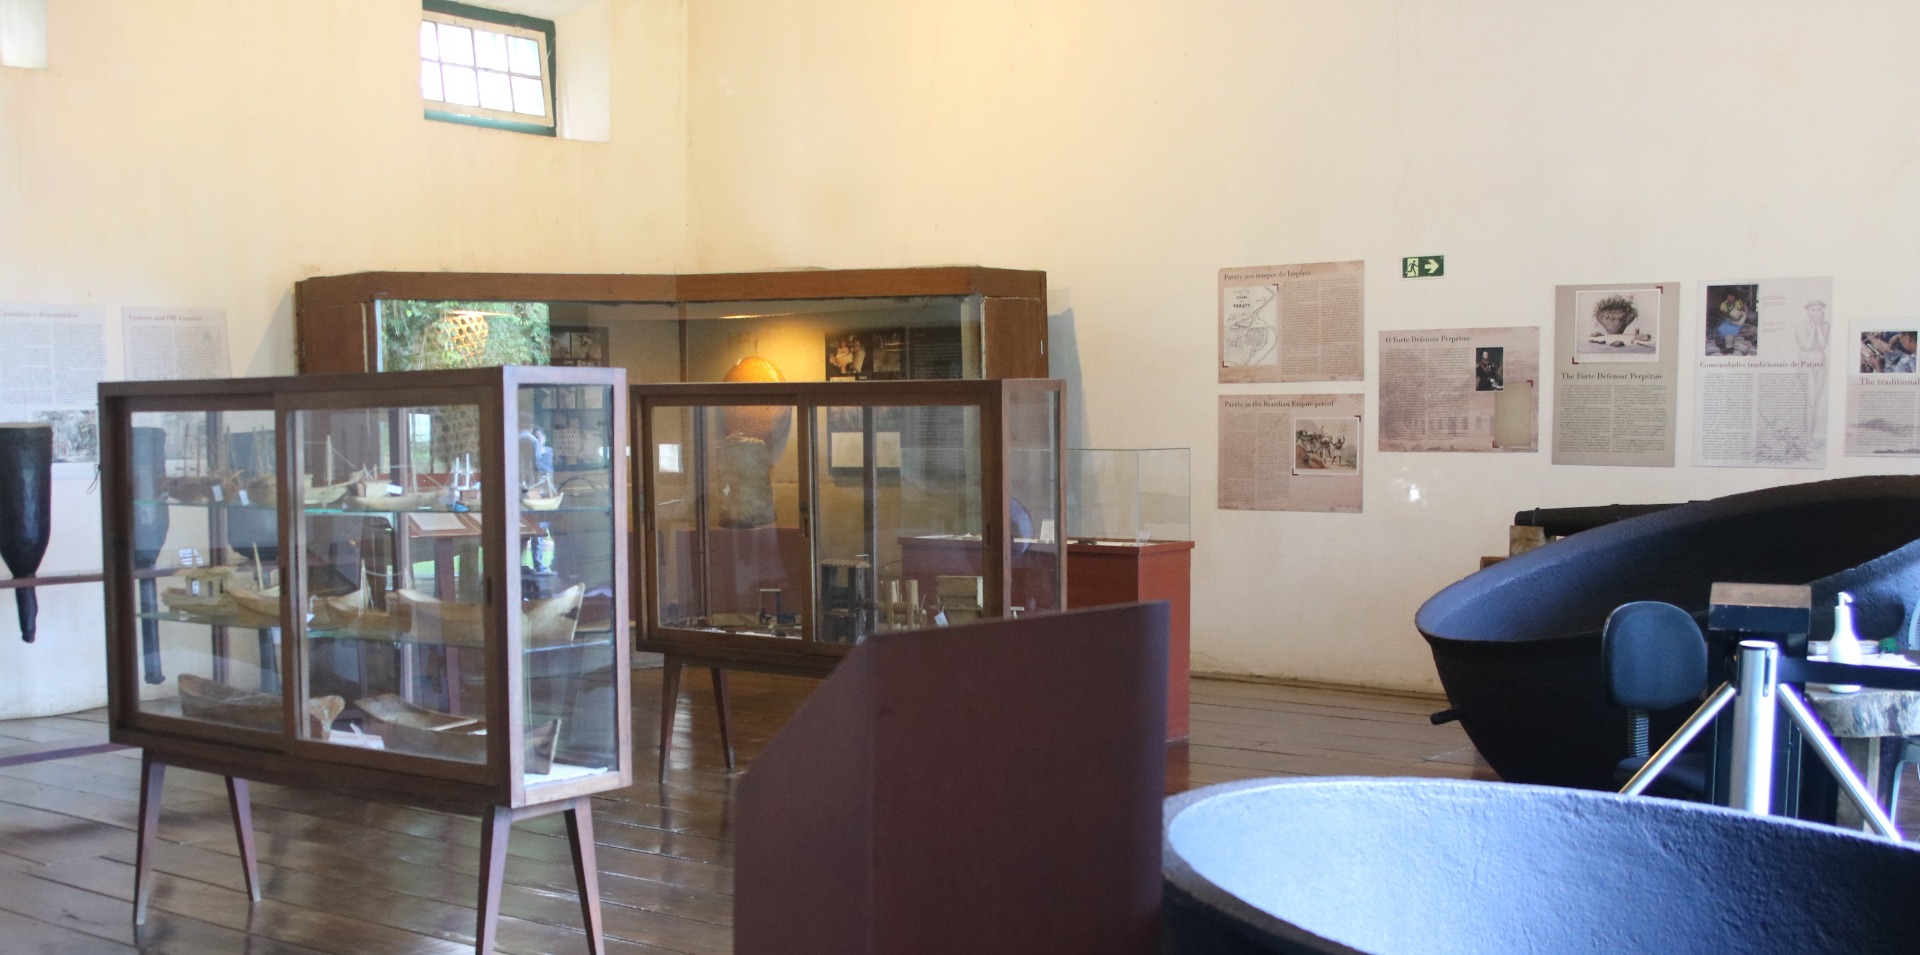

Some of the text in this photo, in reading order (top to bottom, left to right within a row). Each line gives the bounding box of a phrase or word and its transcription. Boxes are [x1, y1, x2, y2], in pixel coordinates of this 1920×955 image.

[1441, 335, 1470, 343] Perpétuo
[1790, 360, 1799, 368] de
[1800, 361, 1824, 369] Paraty
[1561, 372, 1575, 380] The
[1630, 372, 1662, 381] Perpétuo
[1860, 377, 1874, 385] The
[1291, 400, 1313, 409] Empire
[1314, 400, 1334, 409] period
